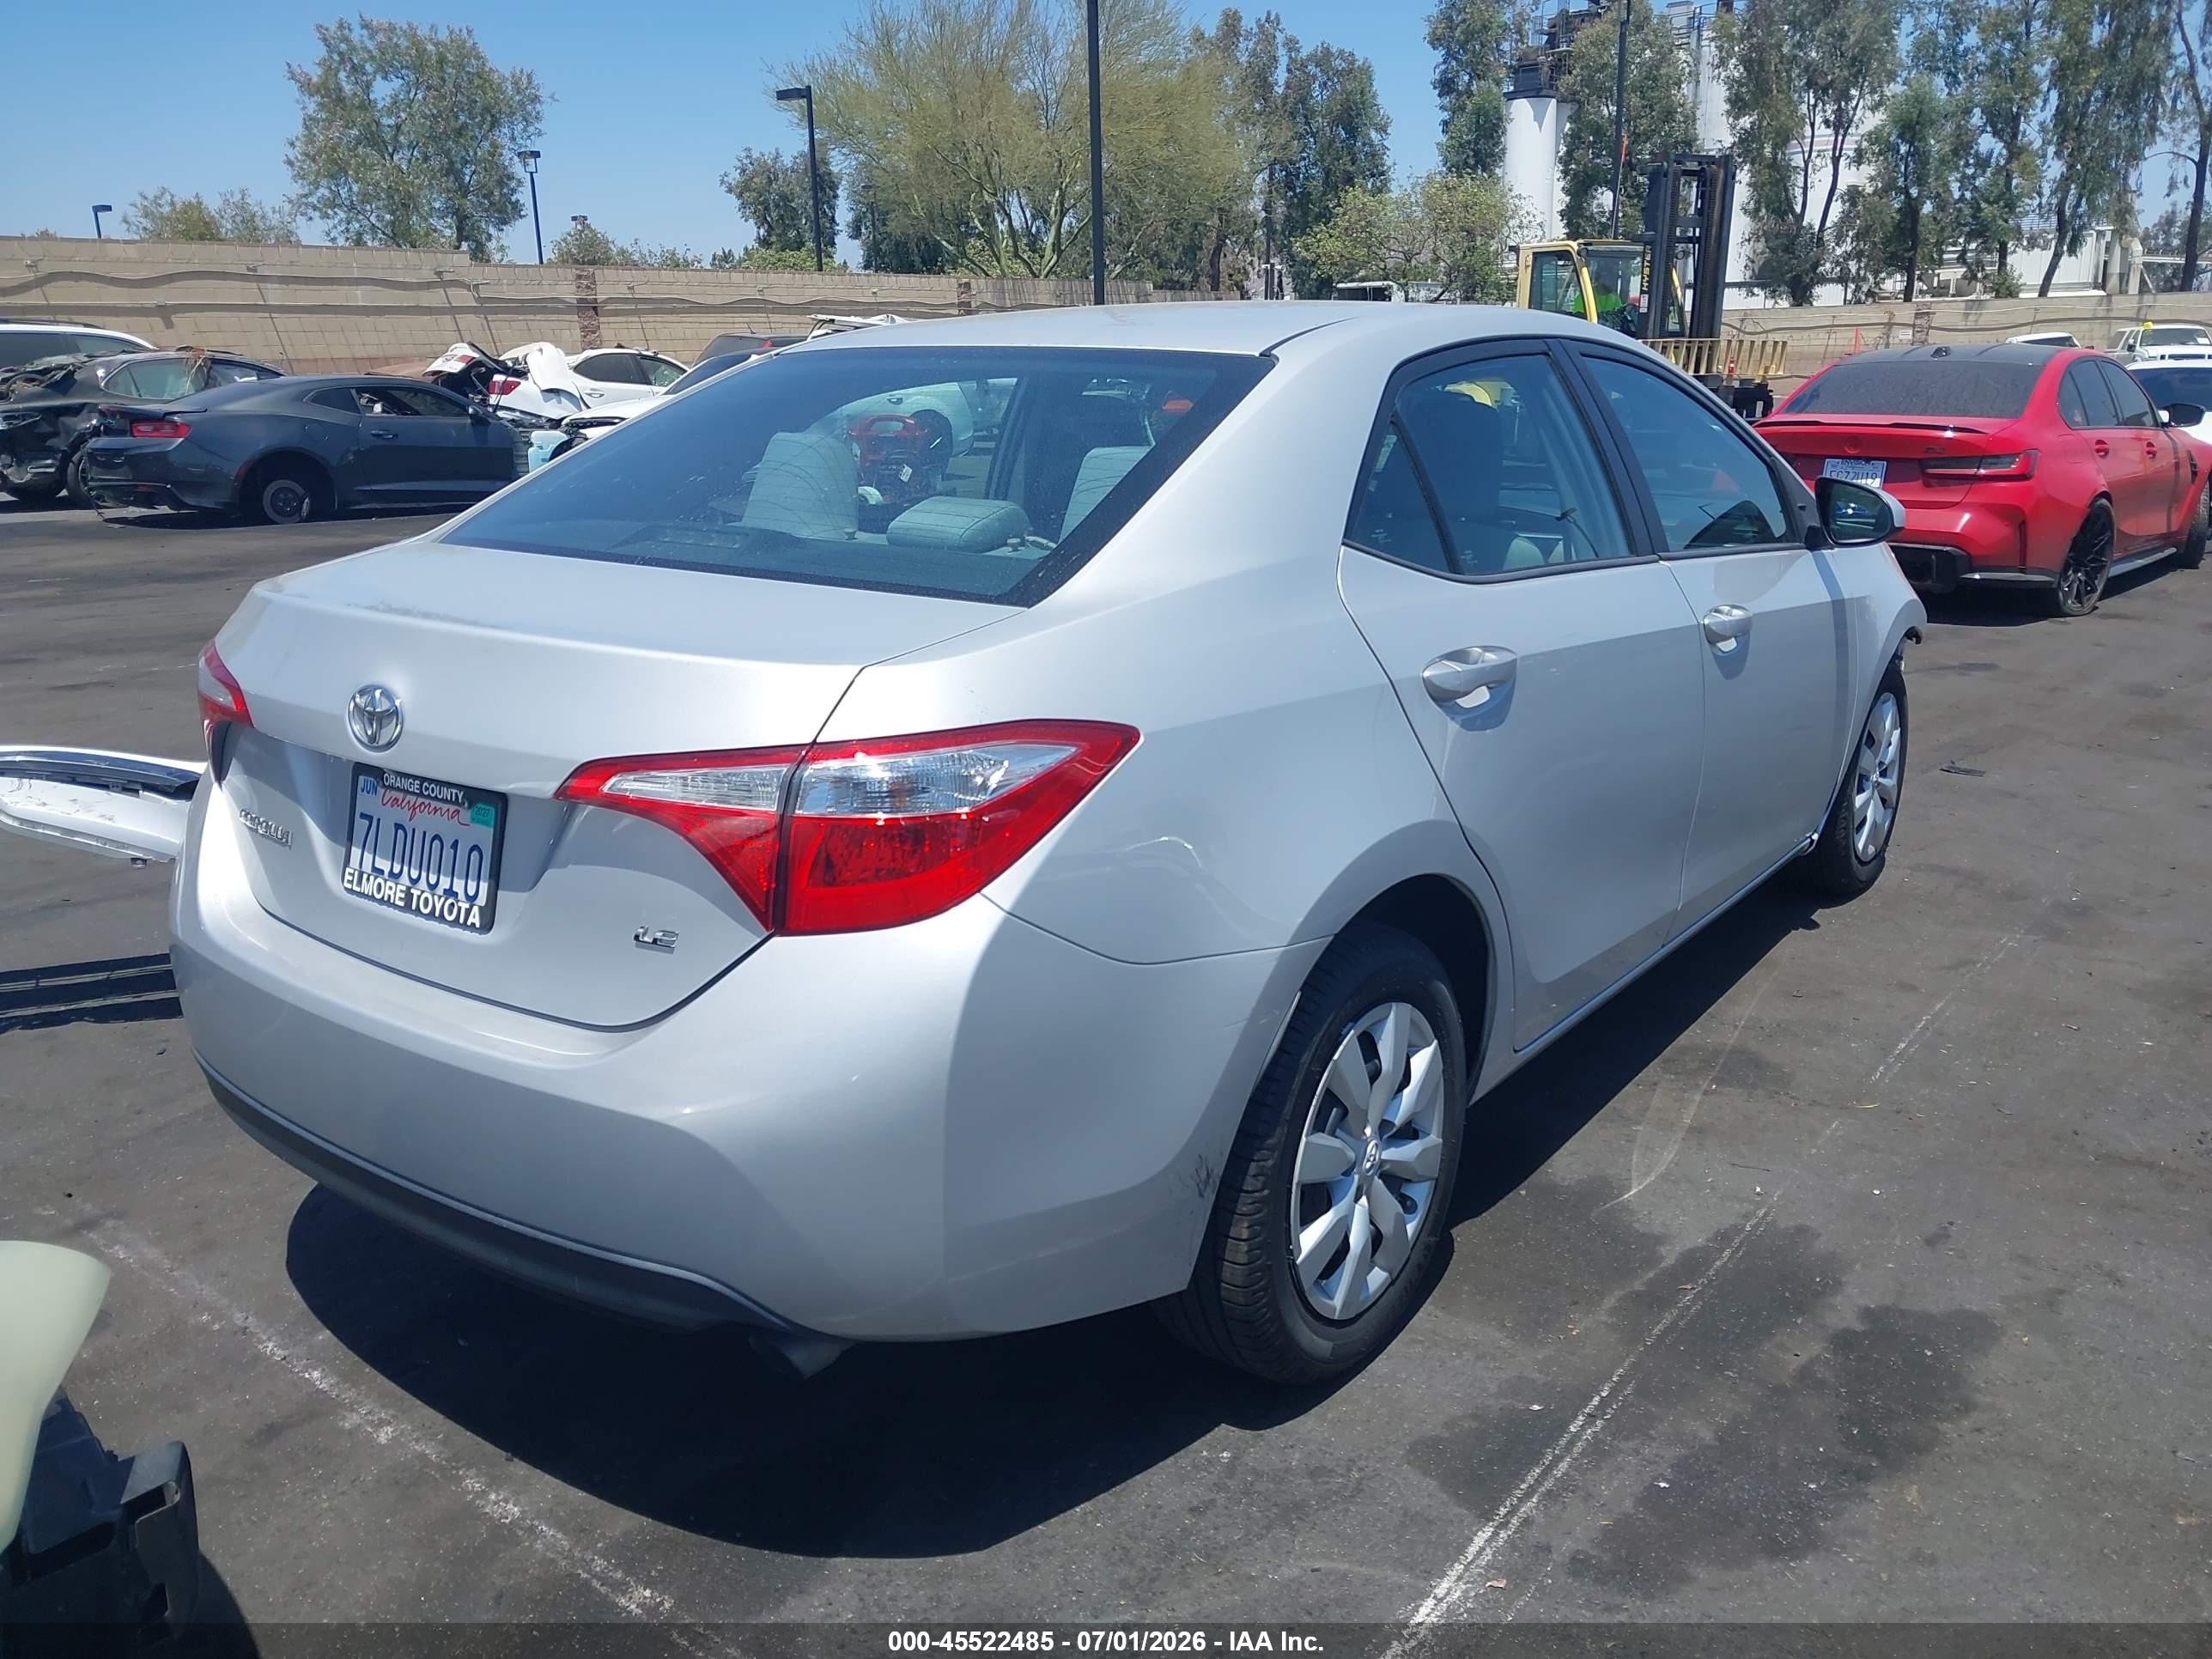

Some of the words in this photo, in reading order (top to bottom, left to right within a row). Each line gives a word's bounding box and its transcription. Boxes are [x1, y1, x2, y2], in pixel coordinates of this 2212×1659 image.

[1641, 245, 1652, 291] HYSTER
[361, 776, 378, 798] JUN
[383, 773, 421, 793] ORANGE
[380, 788, 471, 827] California
[358, 811, 483, 903] 7LDU010
[343, 867, 407, 908] ELMORE
[410, 889, 481, 928] TOYOTA
[634, 927, 679, 949] LE
